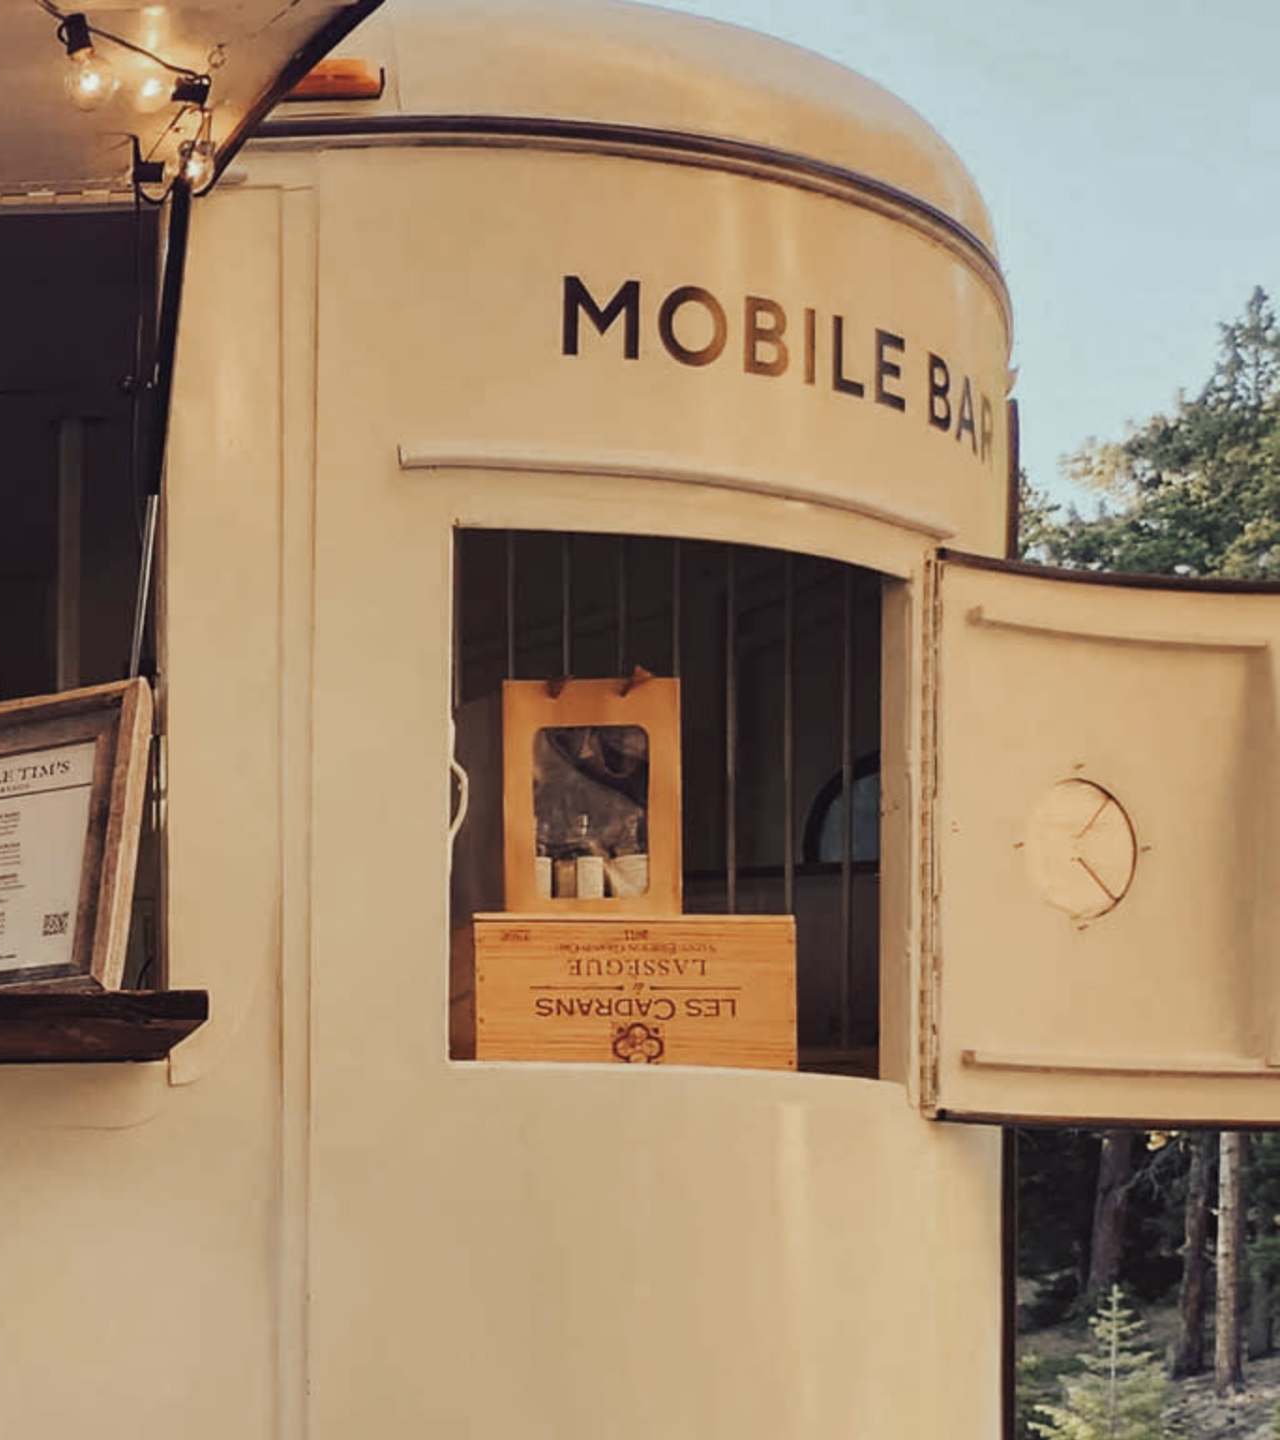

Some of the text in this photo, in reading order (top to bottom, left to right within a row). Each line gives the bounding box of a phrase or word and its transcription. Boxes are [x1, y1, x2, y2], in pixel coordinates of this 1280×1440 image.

[562, 275, 994, 466] MOBILE BAR
[17, 760, 71, 782] TIM'S
[535, 998, 738, 1021] LES CADRANS
